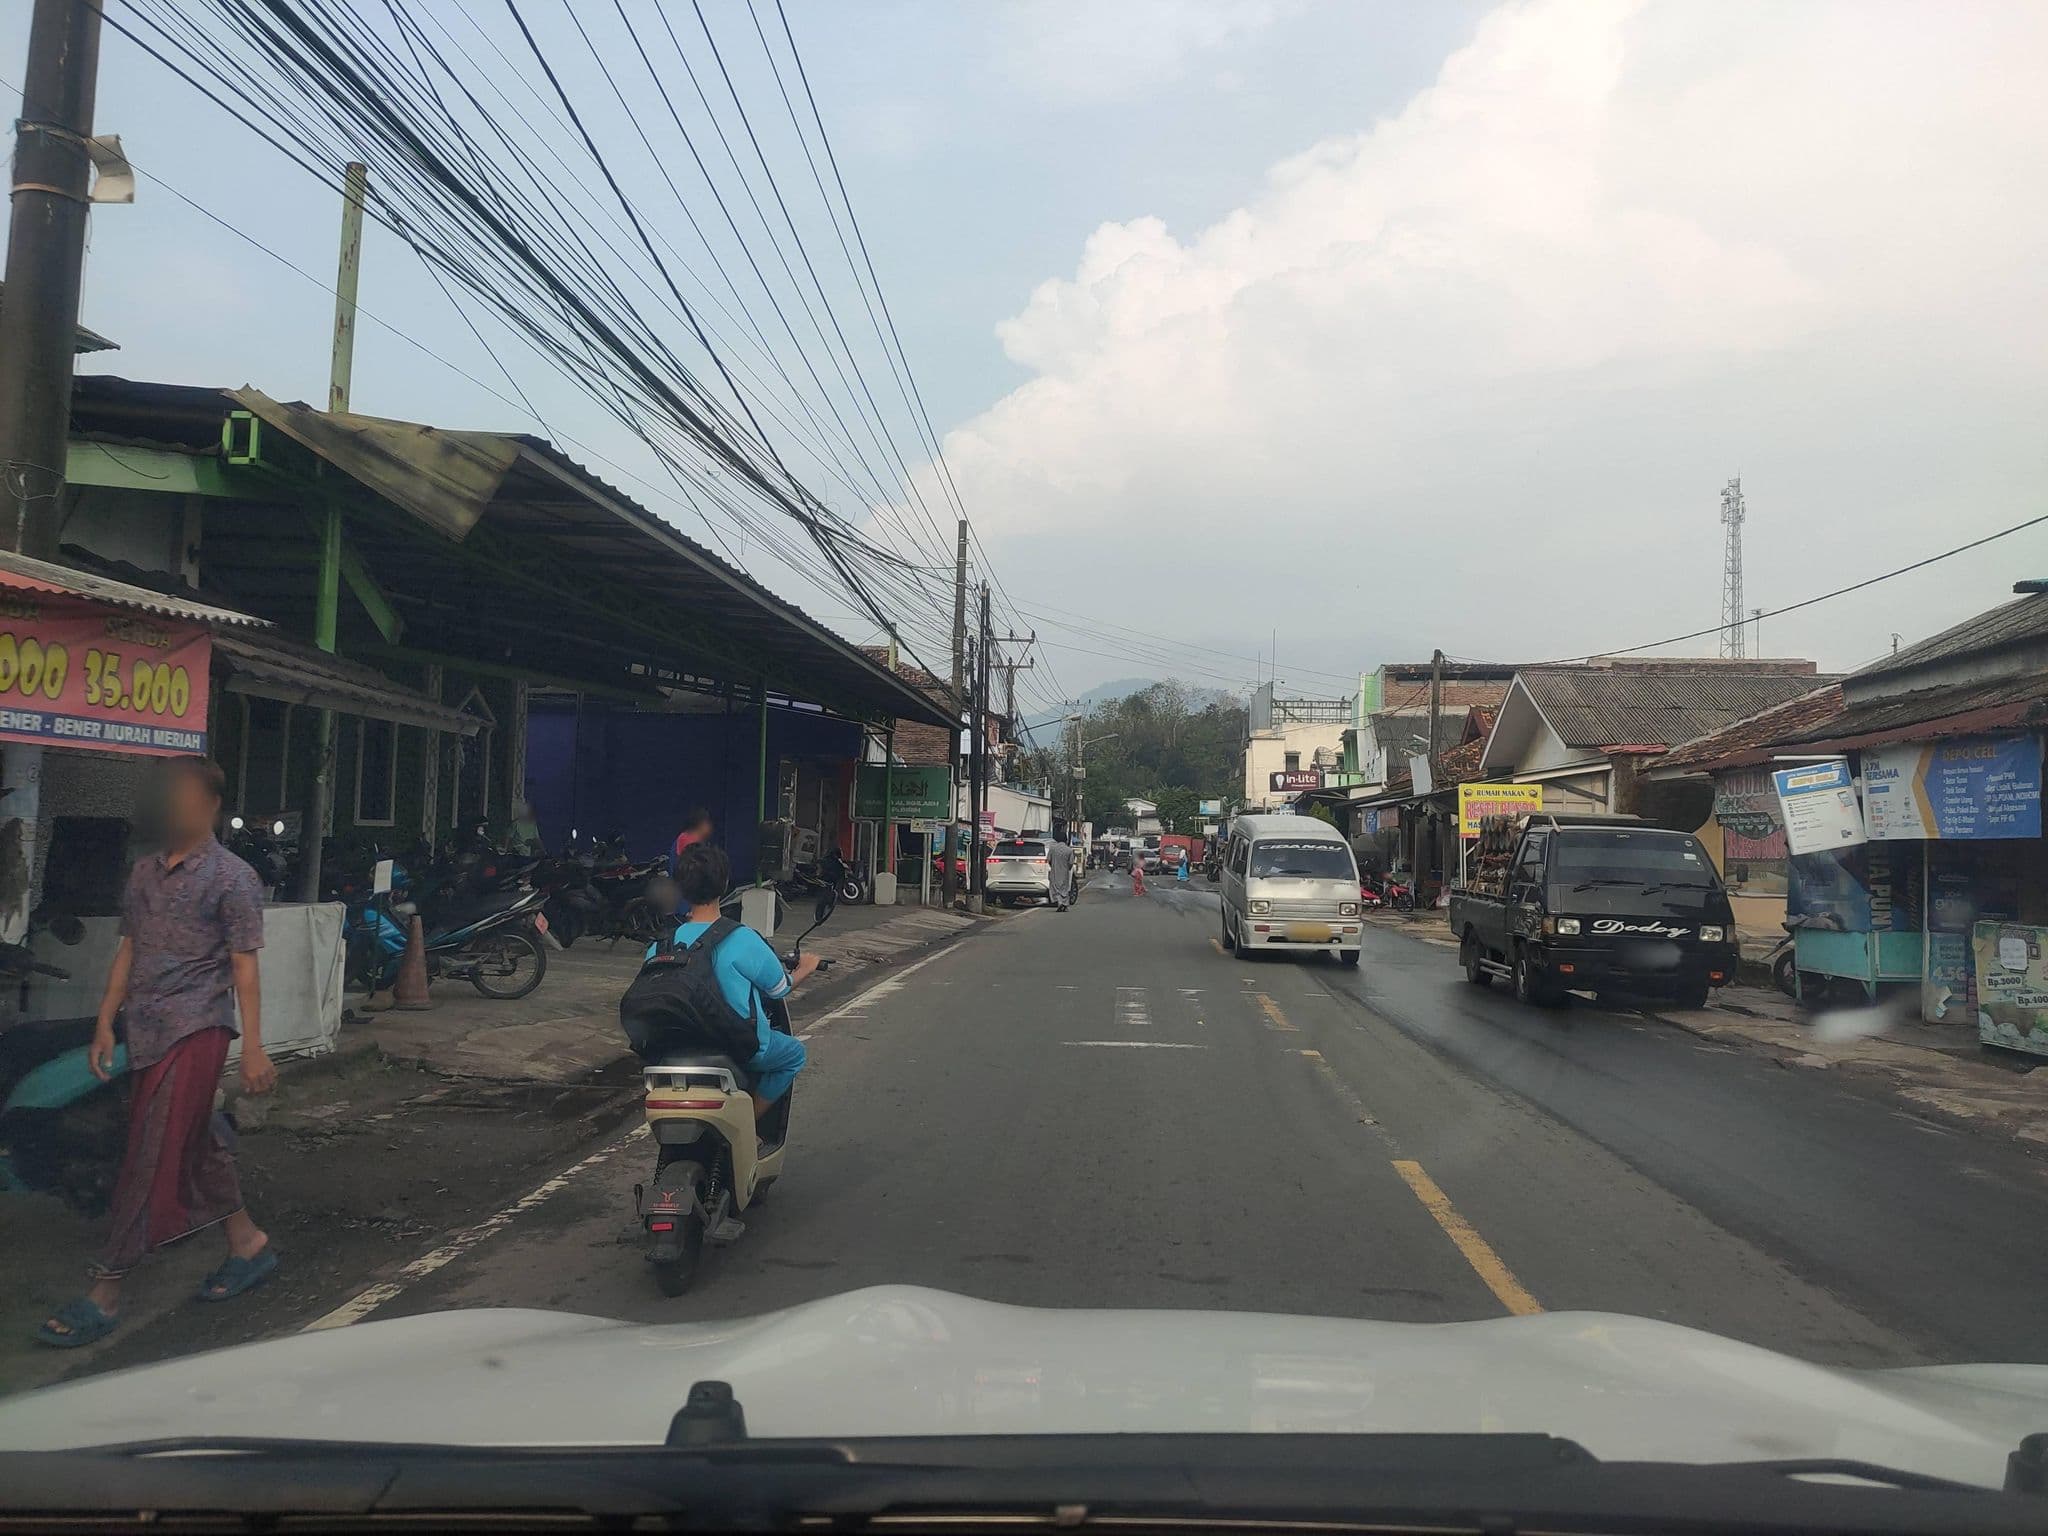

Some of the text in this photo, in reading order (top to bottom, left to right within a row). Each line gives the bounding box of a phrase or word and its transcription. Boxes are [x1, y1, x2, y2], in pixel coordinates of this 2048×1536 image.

[84, 648, 191, 718] 35.000
[54, 717, 100, 738] BENER
[103, 723, 150, 744] MURAH
[153, 729, 201, 749] MERIAH
[1477, 789, 1525, 797] RUMAH MAKAN
